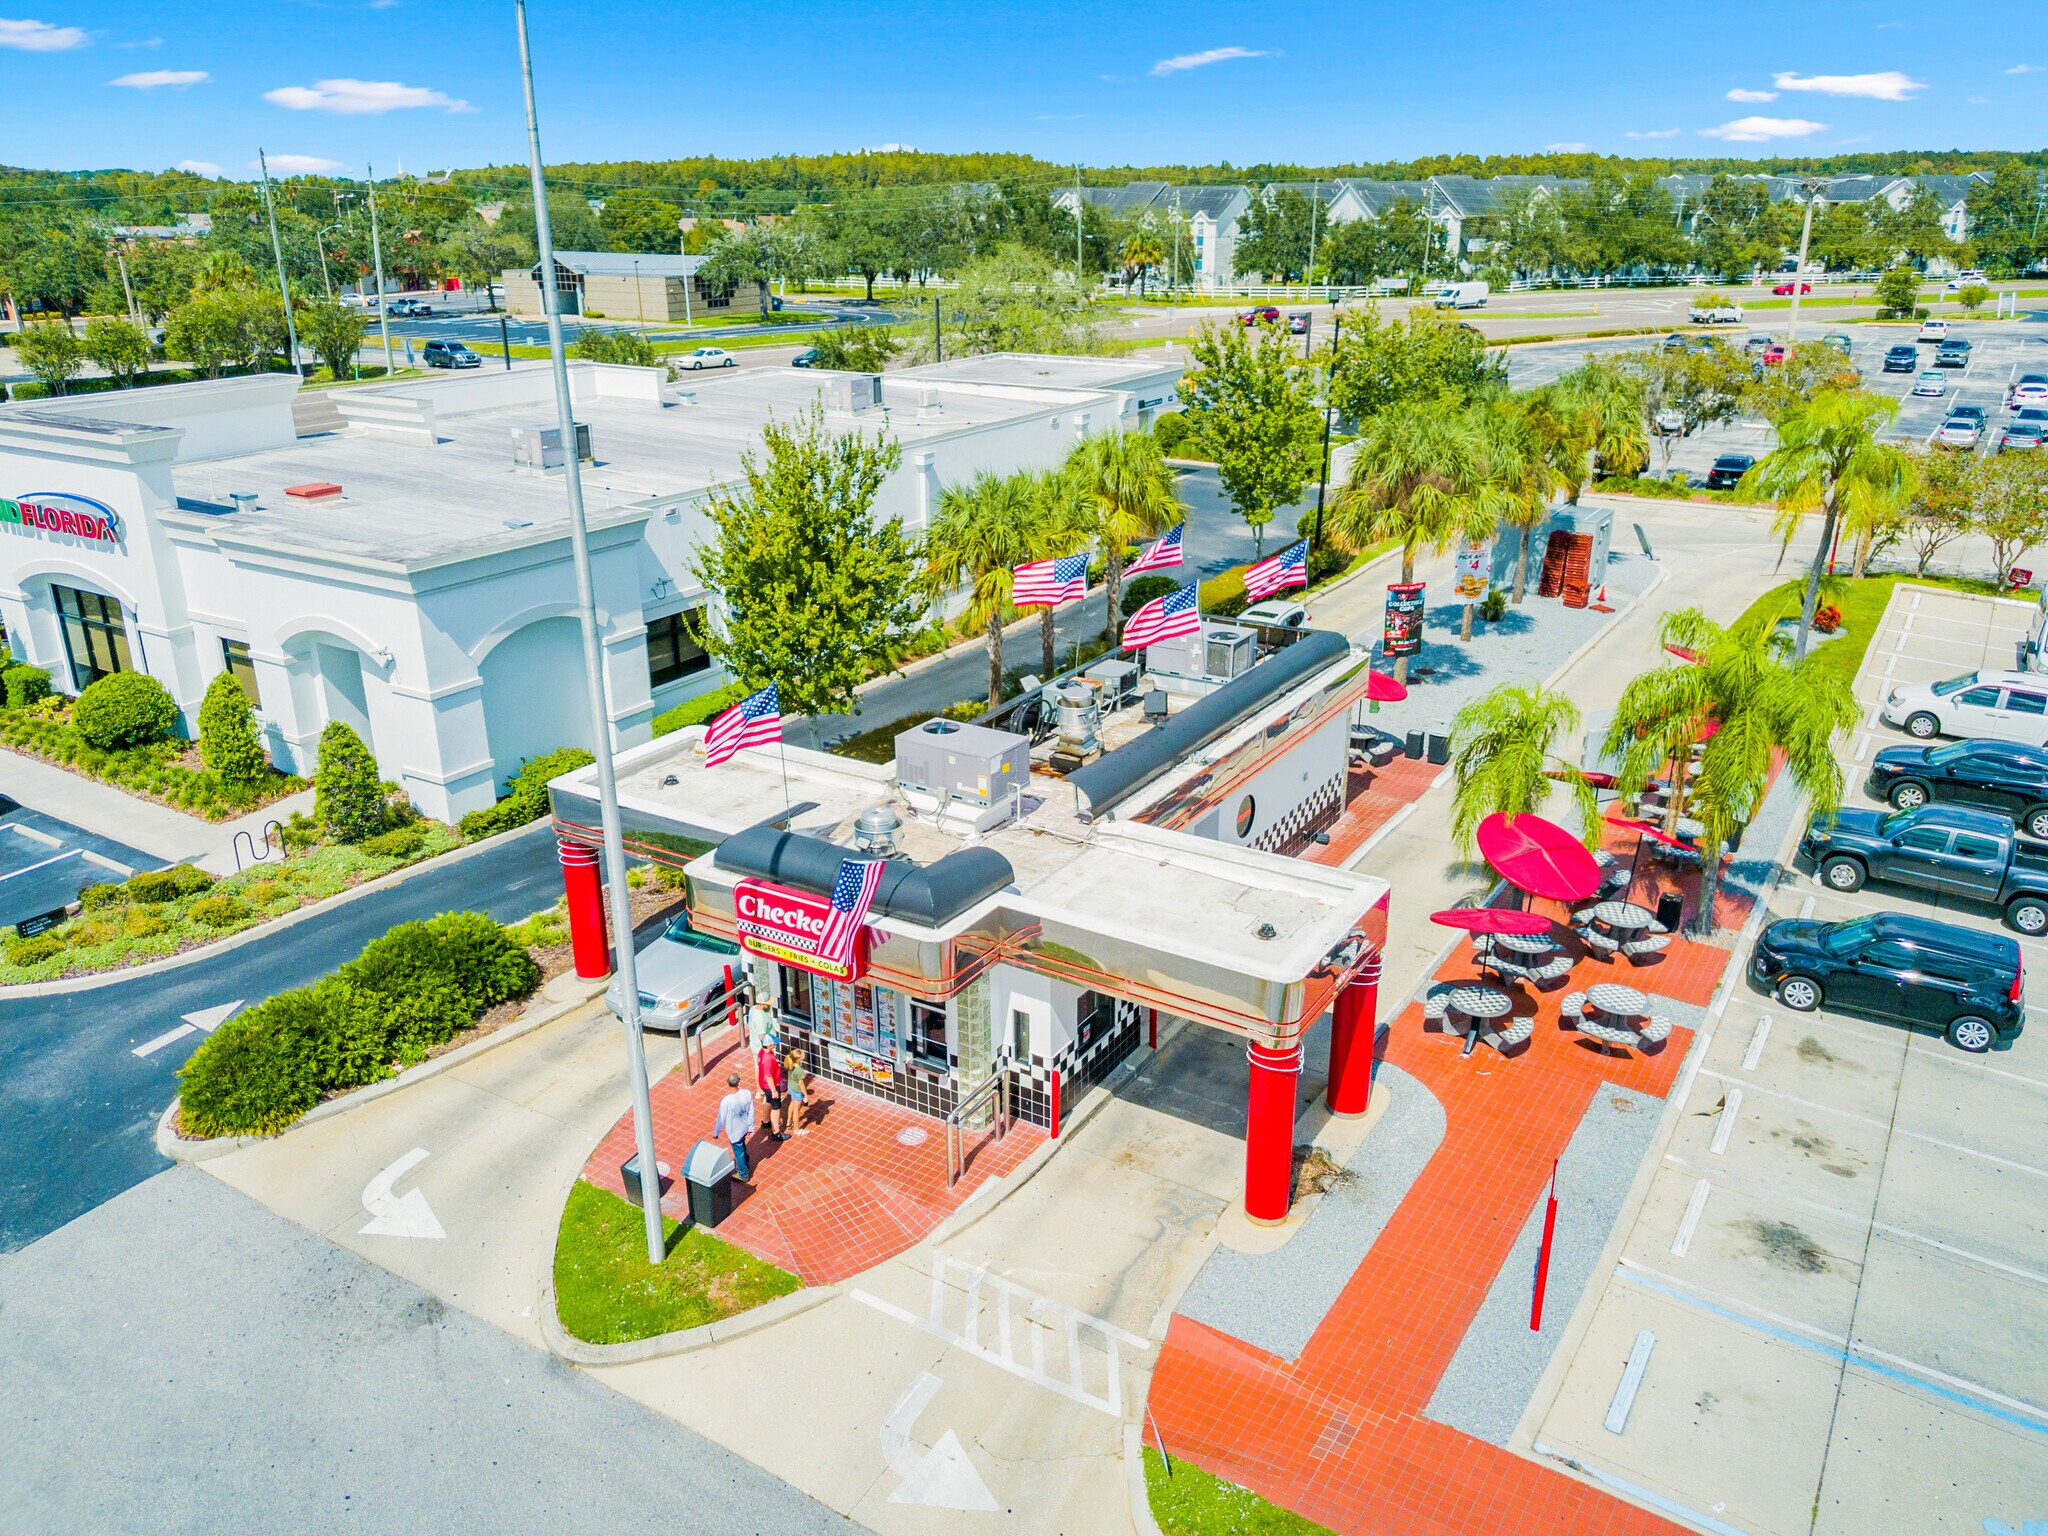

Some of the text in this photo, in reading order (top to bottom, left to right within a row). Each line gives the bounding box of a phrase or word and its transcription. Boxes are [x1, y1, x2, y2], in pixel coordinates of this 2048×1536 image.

[0, 499, 116, 543] IDFLORIDA
[739, 895, 825, 936] Checke
[748, 939, 844, 974] BURGERS FRIES COLAS
